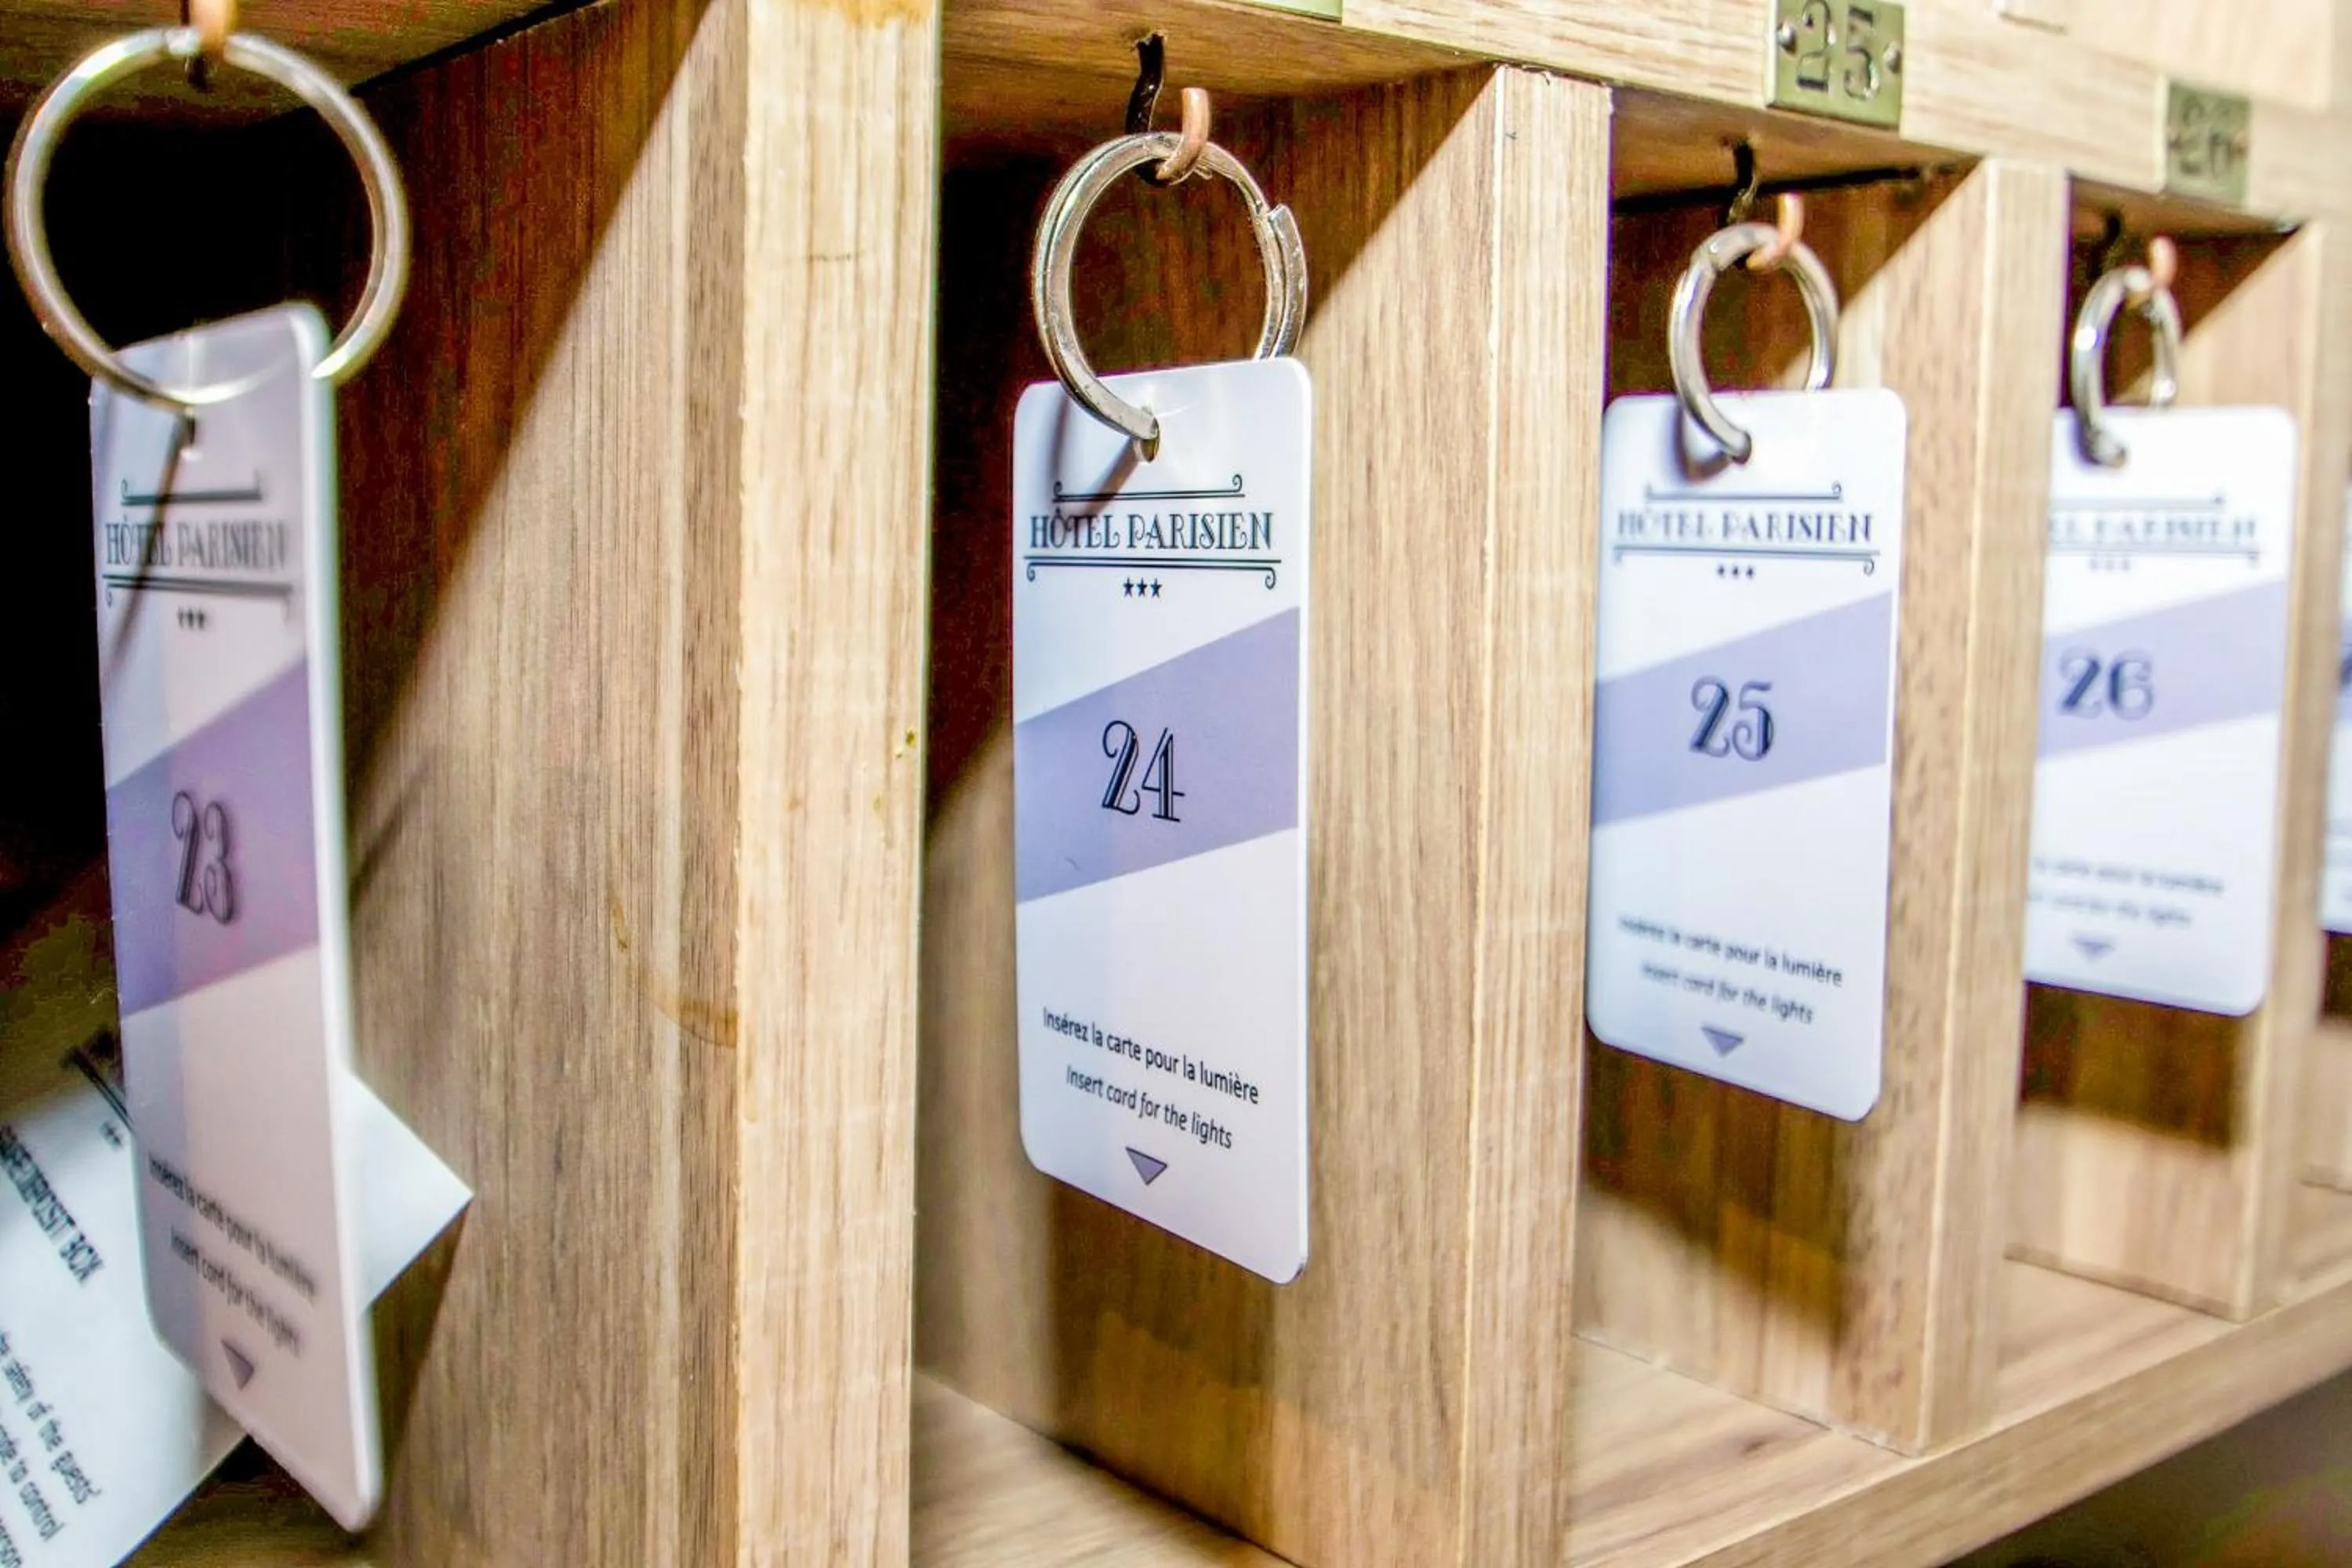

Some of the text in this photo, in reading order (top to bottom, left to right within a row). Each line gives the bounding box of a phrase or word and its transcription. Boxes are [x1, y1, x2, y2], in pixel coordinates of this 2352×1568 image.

[1797, 0, 1878, 101] 25
[176, 520, 288, 571] PARISIEN
[1029, 506, 1275, 550] HÔTEL PARISIEN
[1722, 510, 1872, 542] PARISIEN
[1690, 674, 1775, 762] 25
[2057, 646, 2154, 720] 26
[1102, 720, 1185, 822] 24
[171, 790, 237, 926] 23
[1724, 941, 1761, 965] pour
[1763, 949, 1777, 971] la
[1781, 952, 1843, 987] lumière
[1742, 987, 1766, 1013] the
[1770, 996, 1814, 1025] lights
[1043, 1007, 1259, 1105] Insérez la carte pour la lumière
[1066, 1064, 1233, 1149] Insert card for the lights
[59, 1229, 105, 1287] BOX
[9, 1459, 28, 1484] to
[19, 1481, 67, 1541] control
